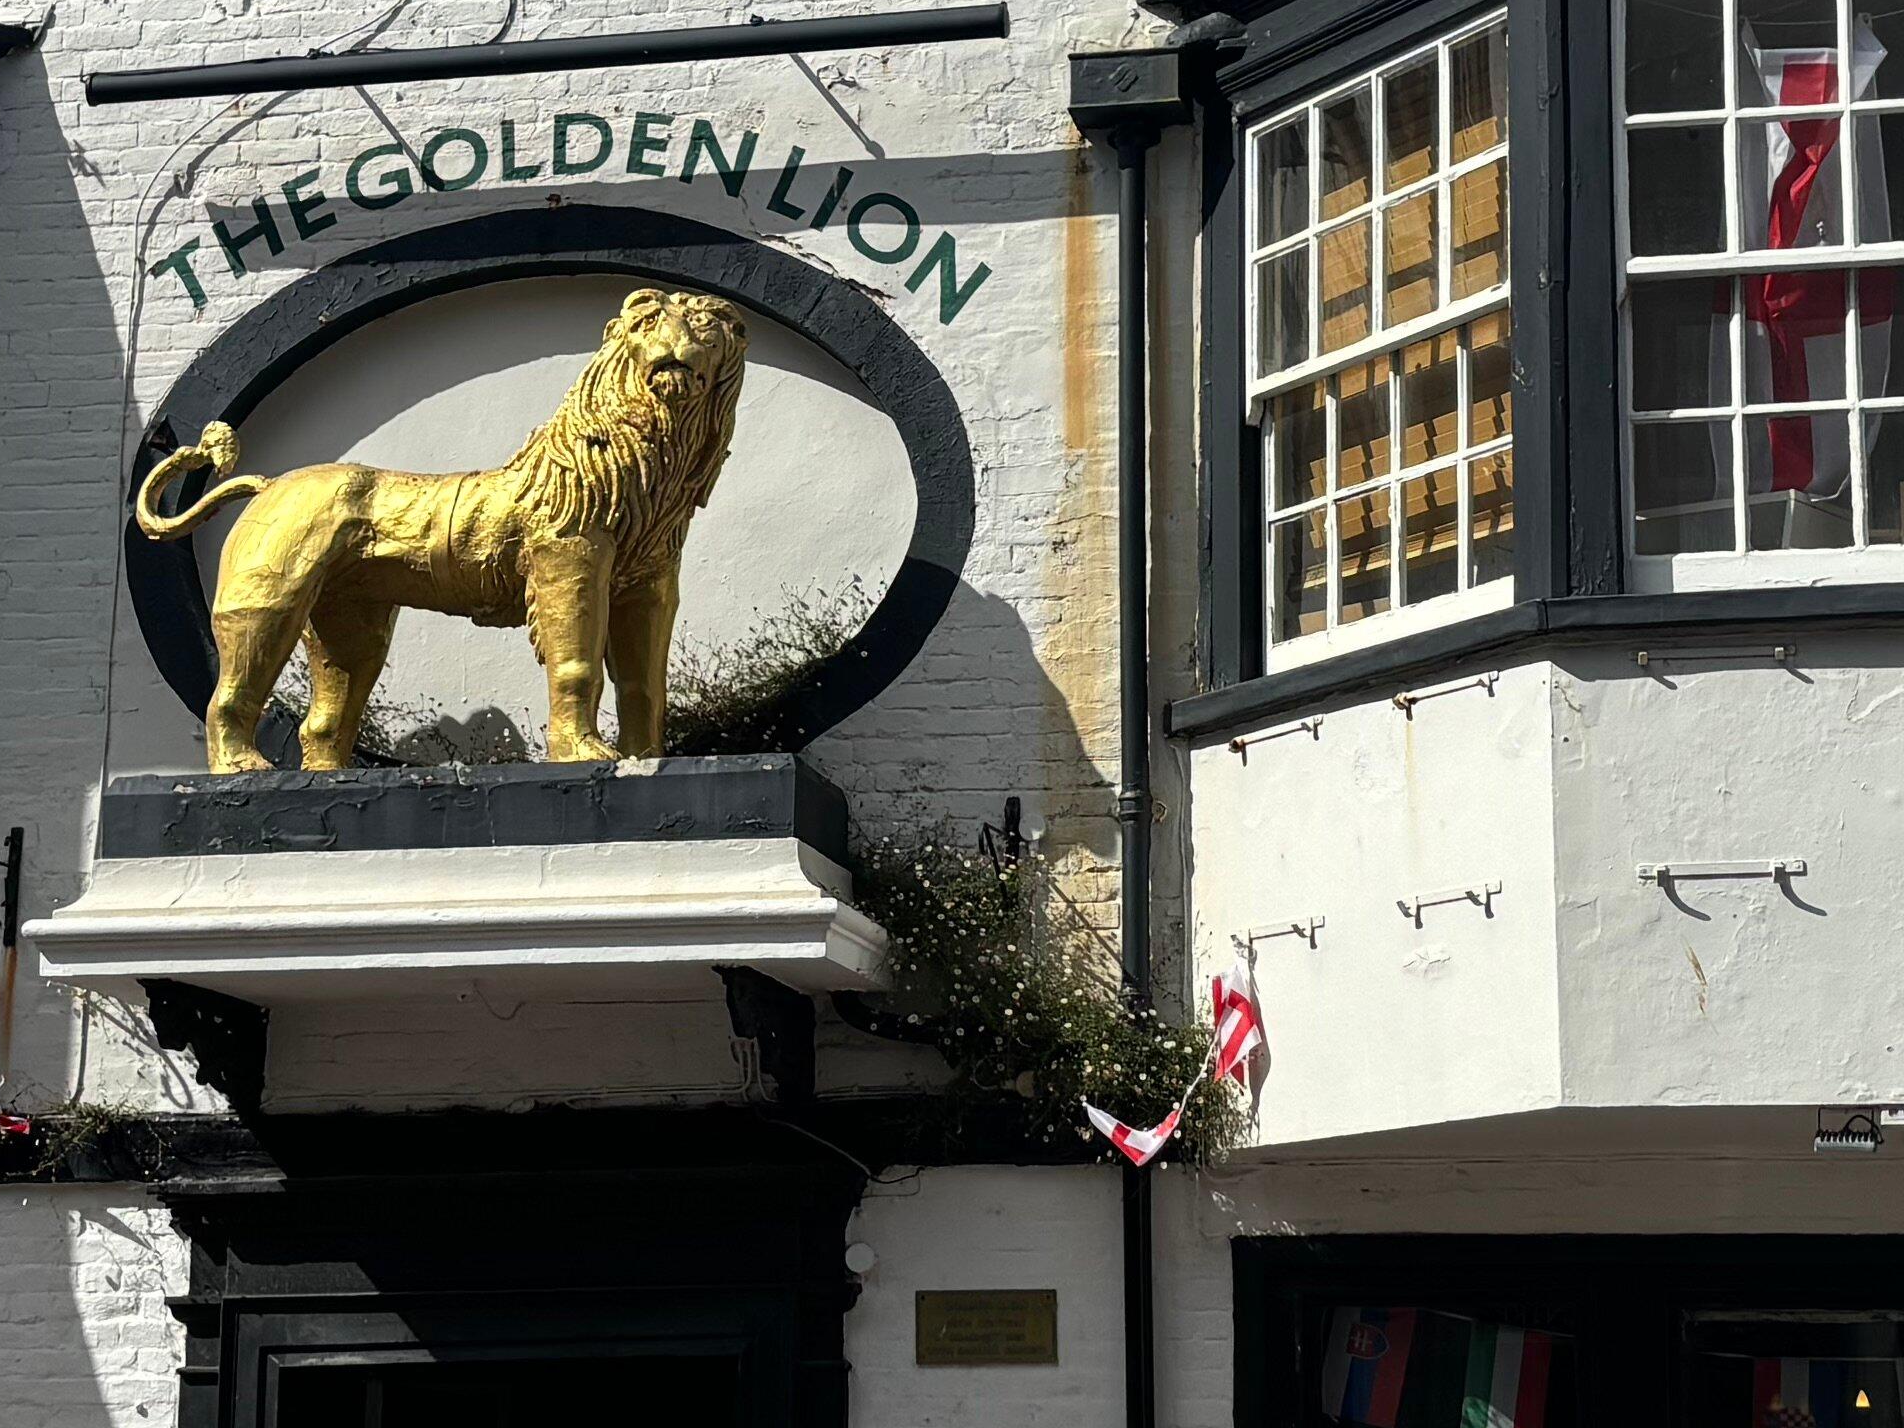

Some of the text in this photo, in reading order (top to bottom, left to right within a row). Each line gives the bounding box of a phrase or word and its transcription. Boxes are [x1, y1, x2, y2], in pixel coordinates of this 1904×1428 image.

[148, 112, 993, 326] THE GOLDEN LION
